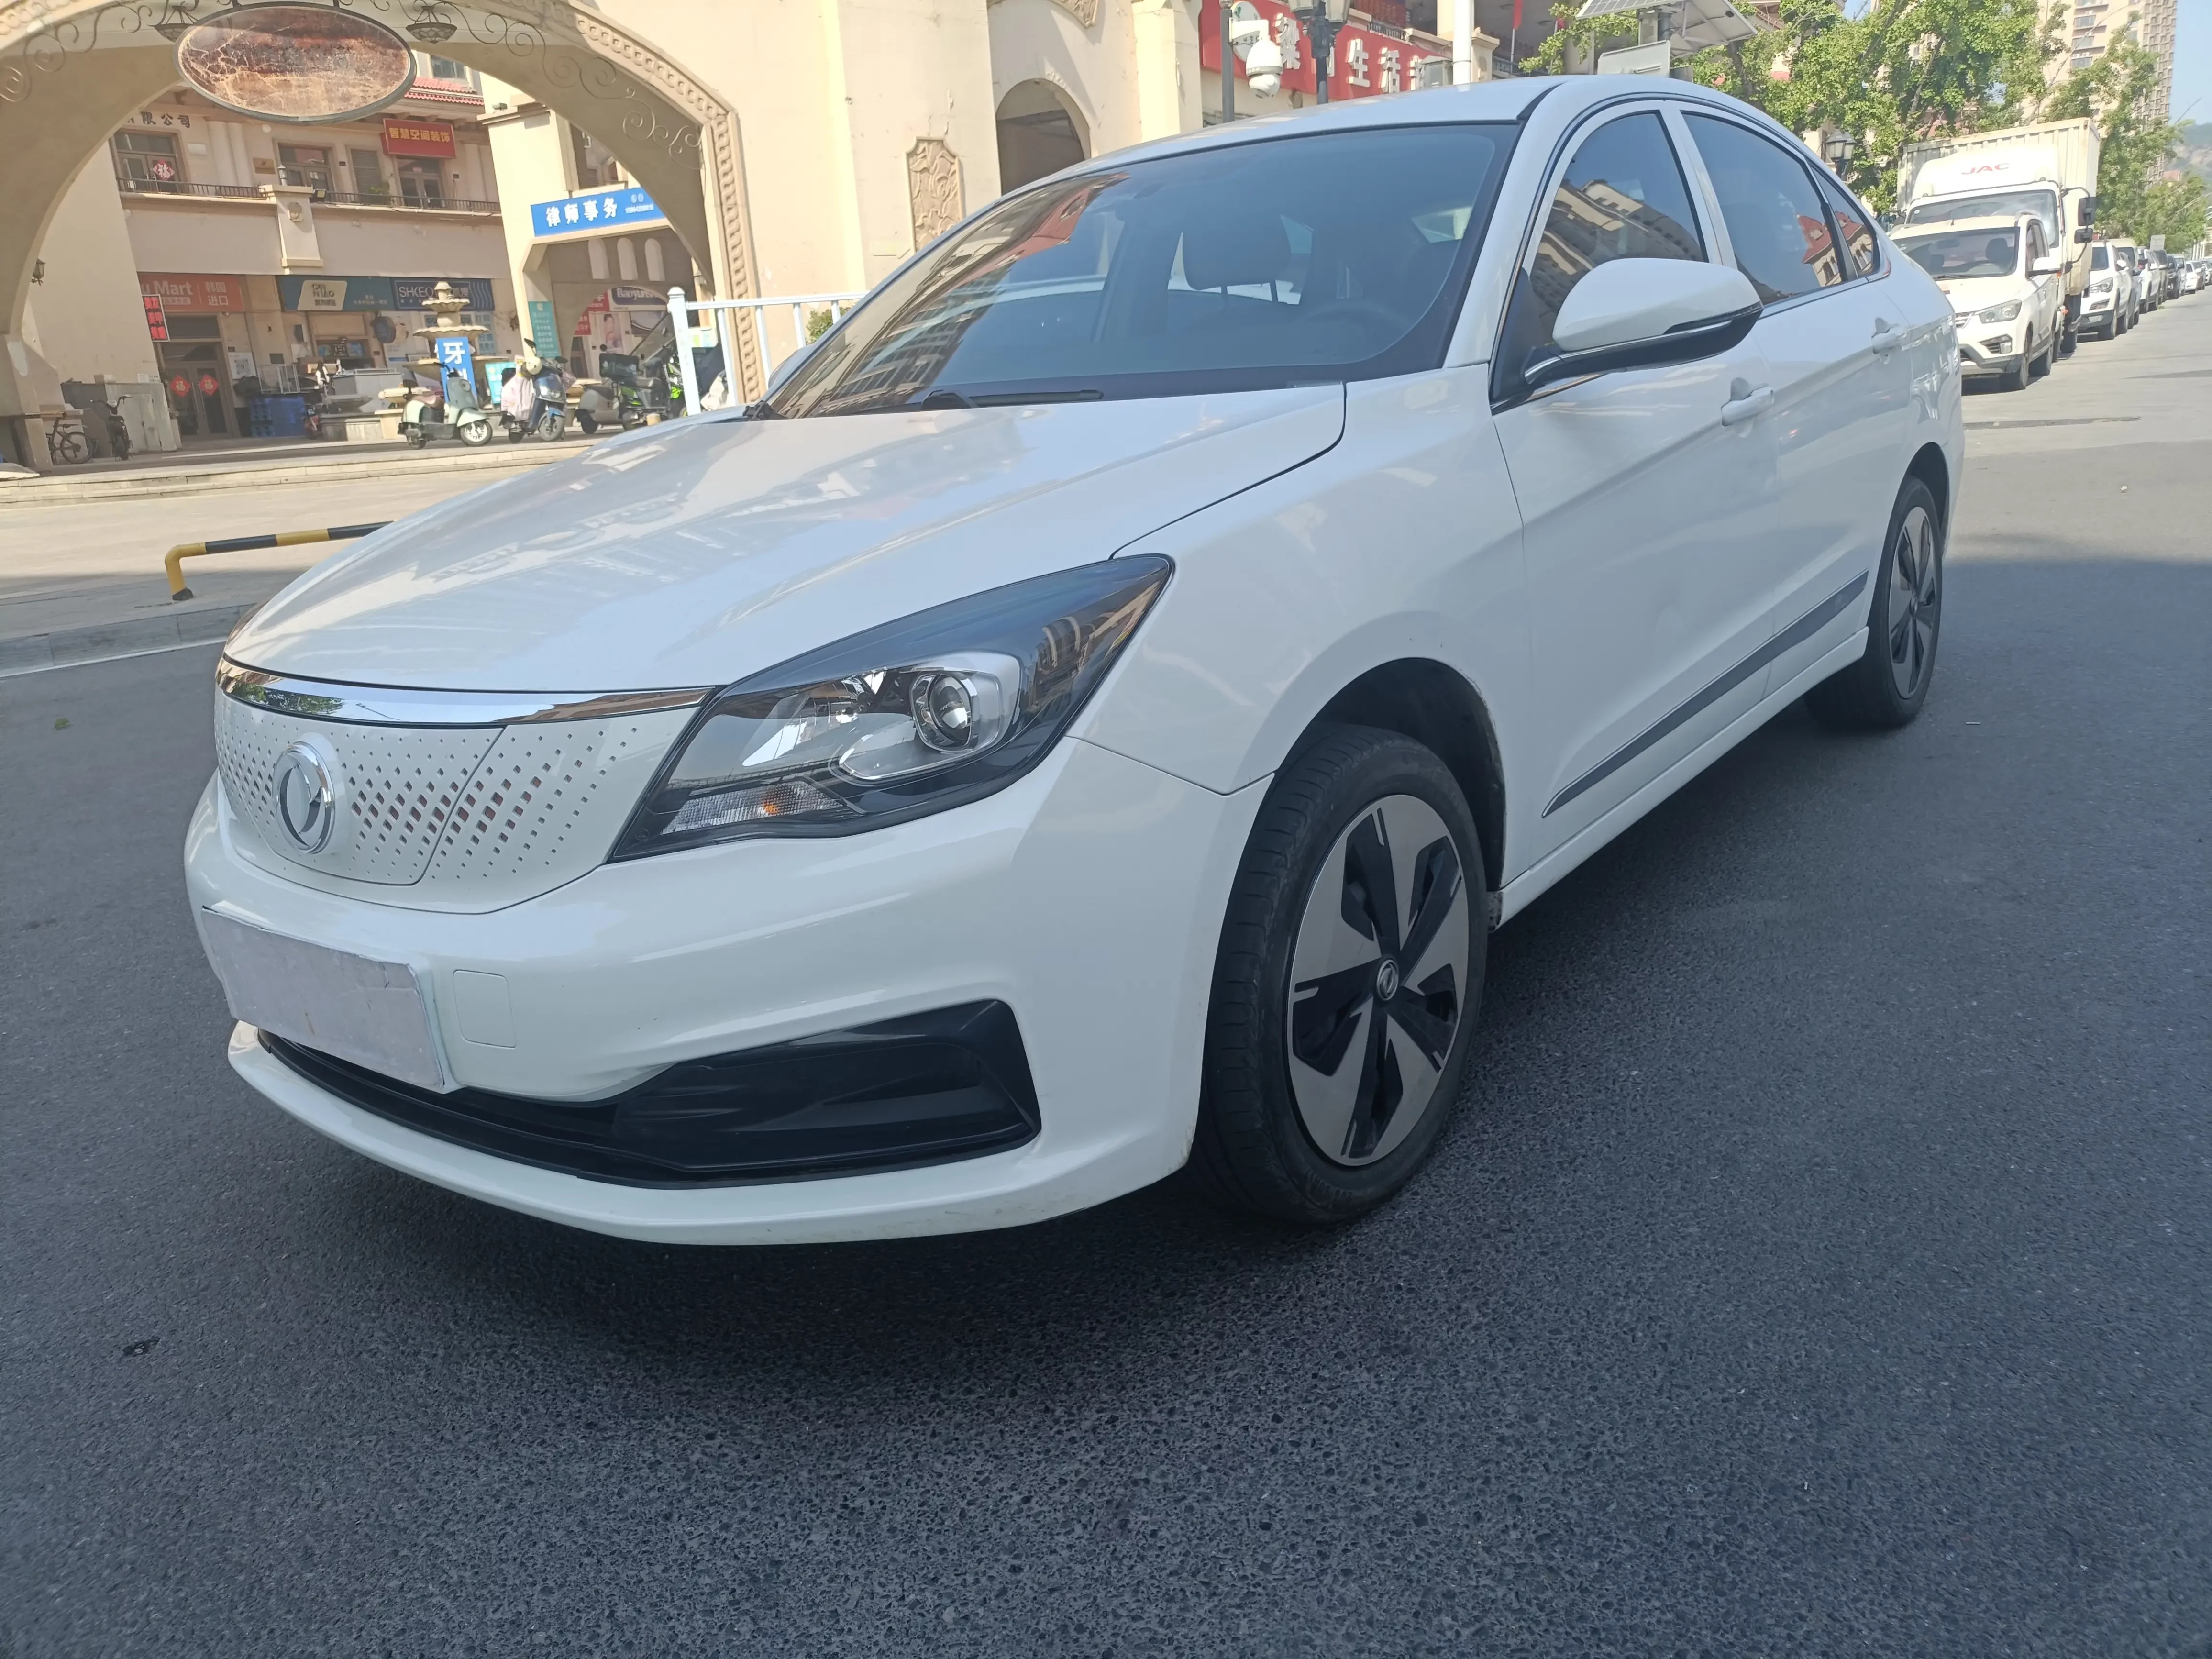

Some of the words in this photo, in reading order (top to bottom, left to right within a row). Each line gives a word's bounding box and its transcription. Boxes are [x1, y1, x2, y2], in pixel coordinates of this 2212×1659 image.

[389, 127, 450, 142] 智慧空间装饰
[158, 163, 171, 178] 福
[1961, 163, 2010, 175] JAC
[546, 197, 618, 227] 律师事务
[153, 280, 194, 295] Mart
[205, 281, 226, 293] 韩国
[208, 295, 229, 306] 进口
[475, 314, 490, 324] 打印
